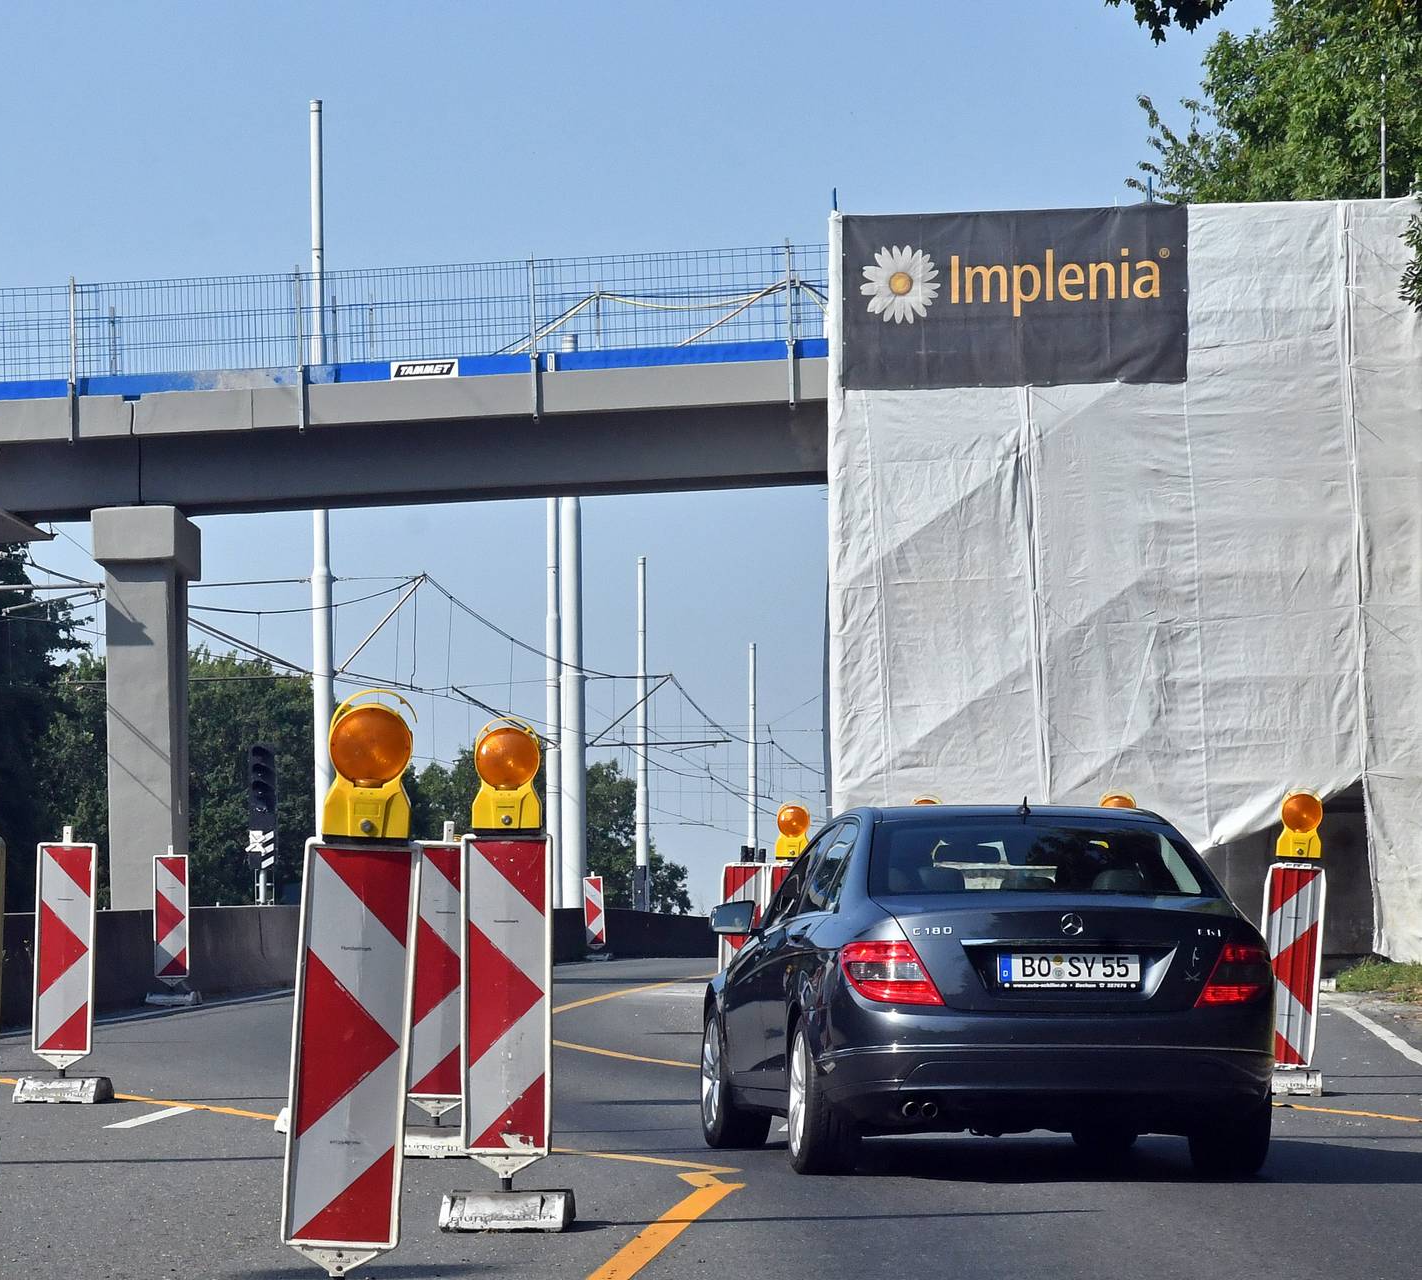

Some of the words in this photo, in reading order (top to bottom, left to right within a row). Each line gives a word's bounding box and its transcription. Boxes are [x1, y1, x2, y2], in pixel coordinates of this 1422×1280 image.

[924, 926, 954, 935] 180
[1021, 956, 1051, 978] BO
[1067, 956, 1097, 978] SY
[1101, 956, 1130, 978] 55
[1002, 970, 1009, 978] D
